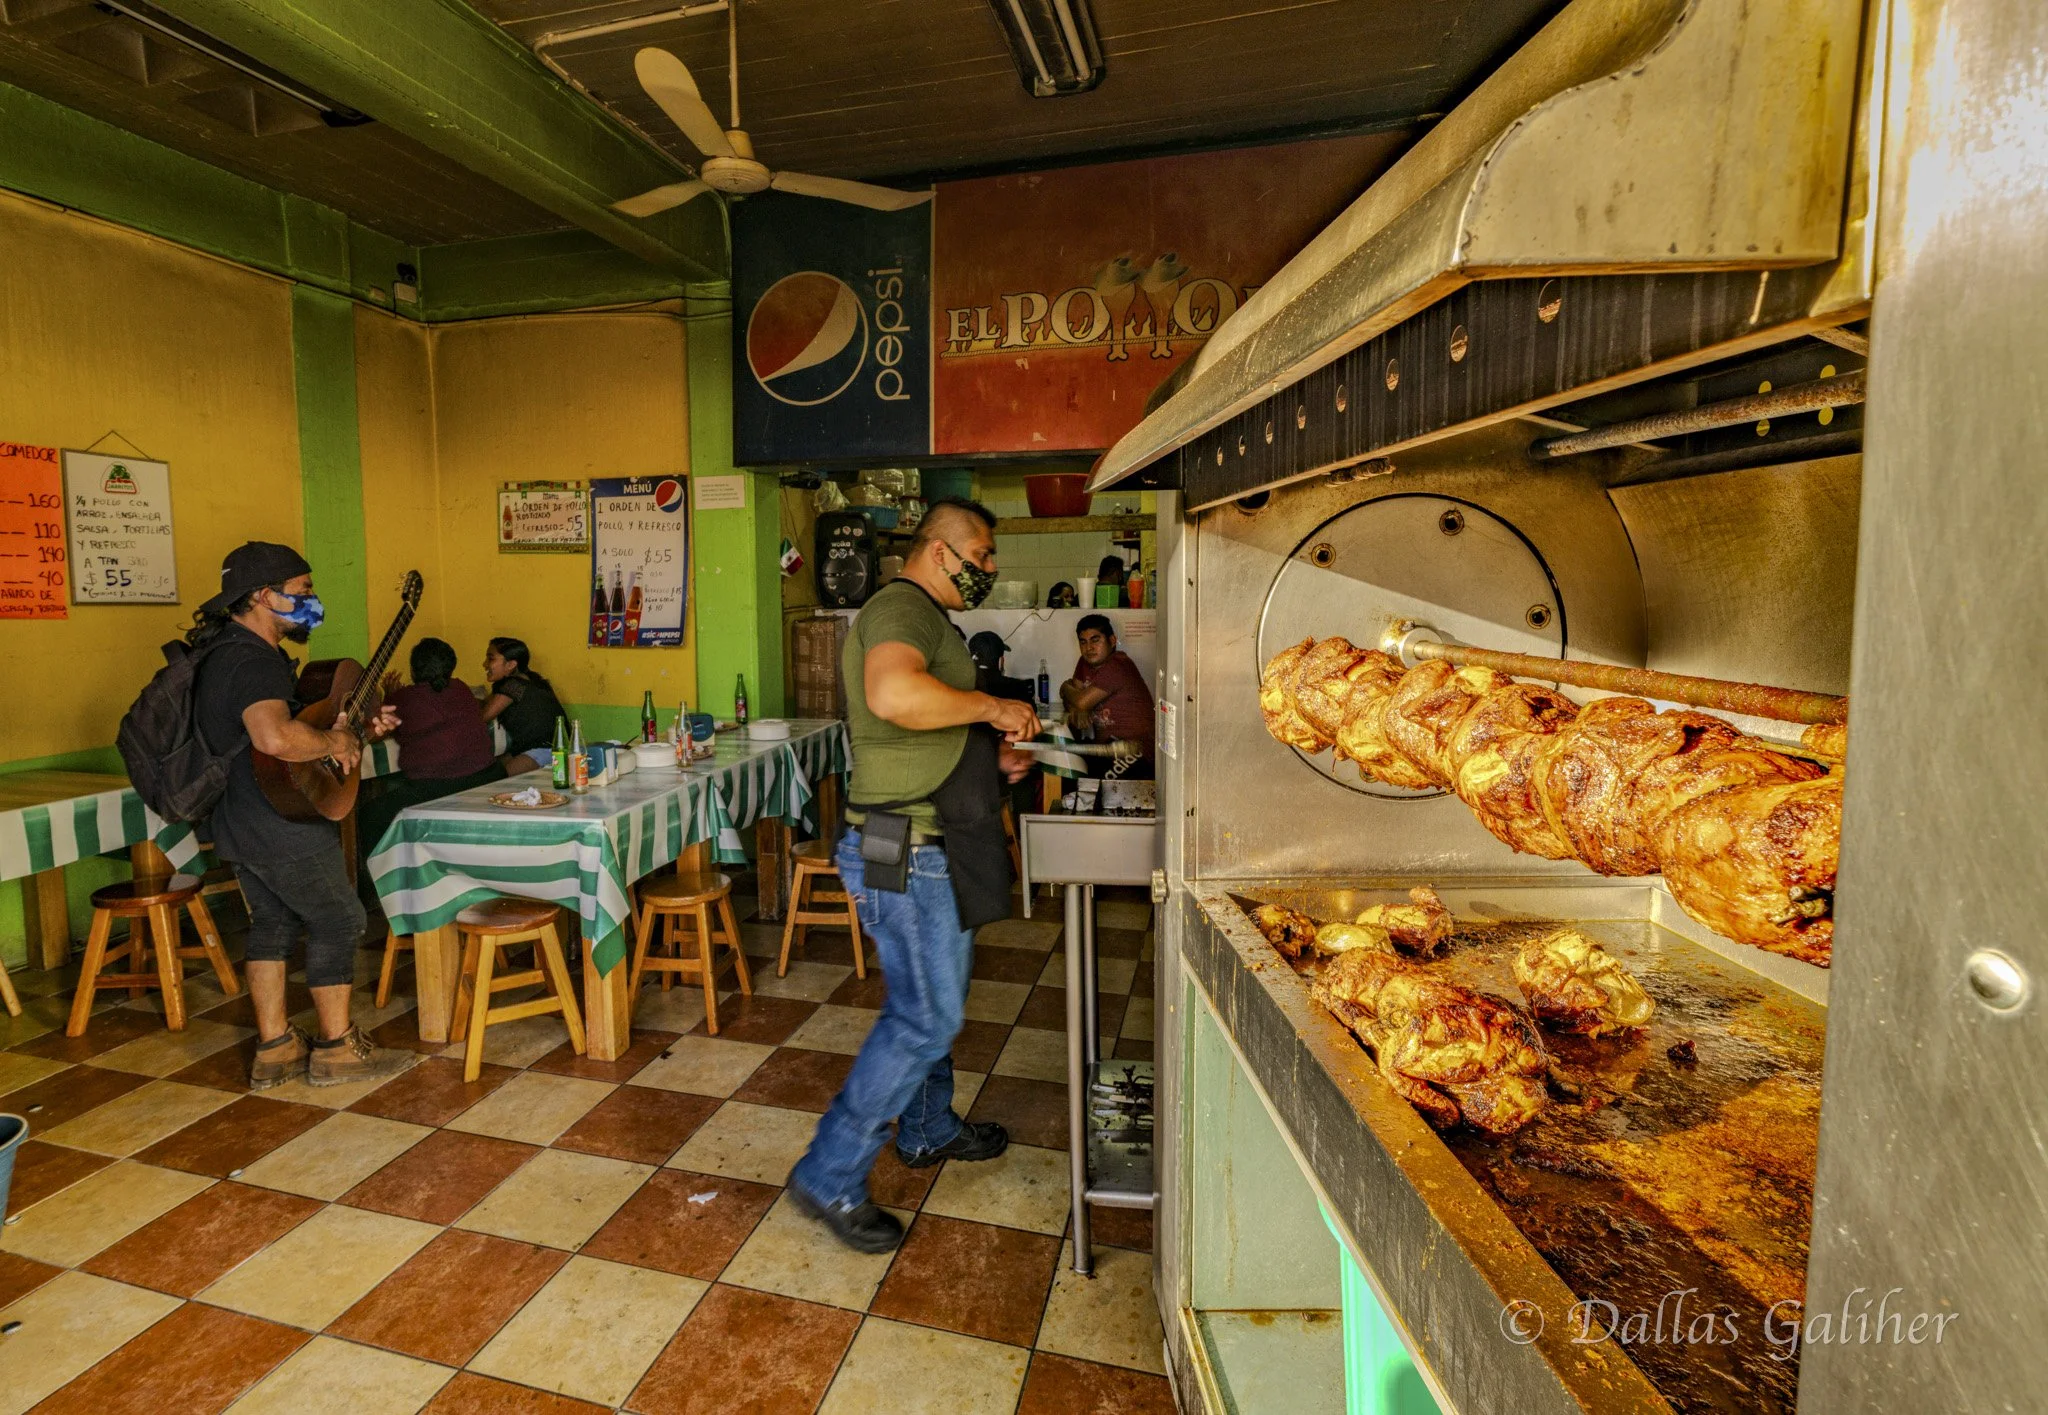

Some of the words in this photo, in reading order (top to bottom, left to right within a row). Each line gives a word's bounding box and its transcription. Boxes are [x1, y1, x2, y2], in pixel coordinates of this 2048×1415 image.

[946, 306, 1002, 343] EL
[867, 268, 911, 401] pepsi
[623, 480, 652, 494] MENÚ
[28, 493, 61, 509] 160
[609, 502, 641, 512] ORDEN
[34, 523, 61, 539] 110
[38, 546, 65, 563] 140
[38, 571, 64, 587] 40
